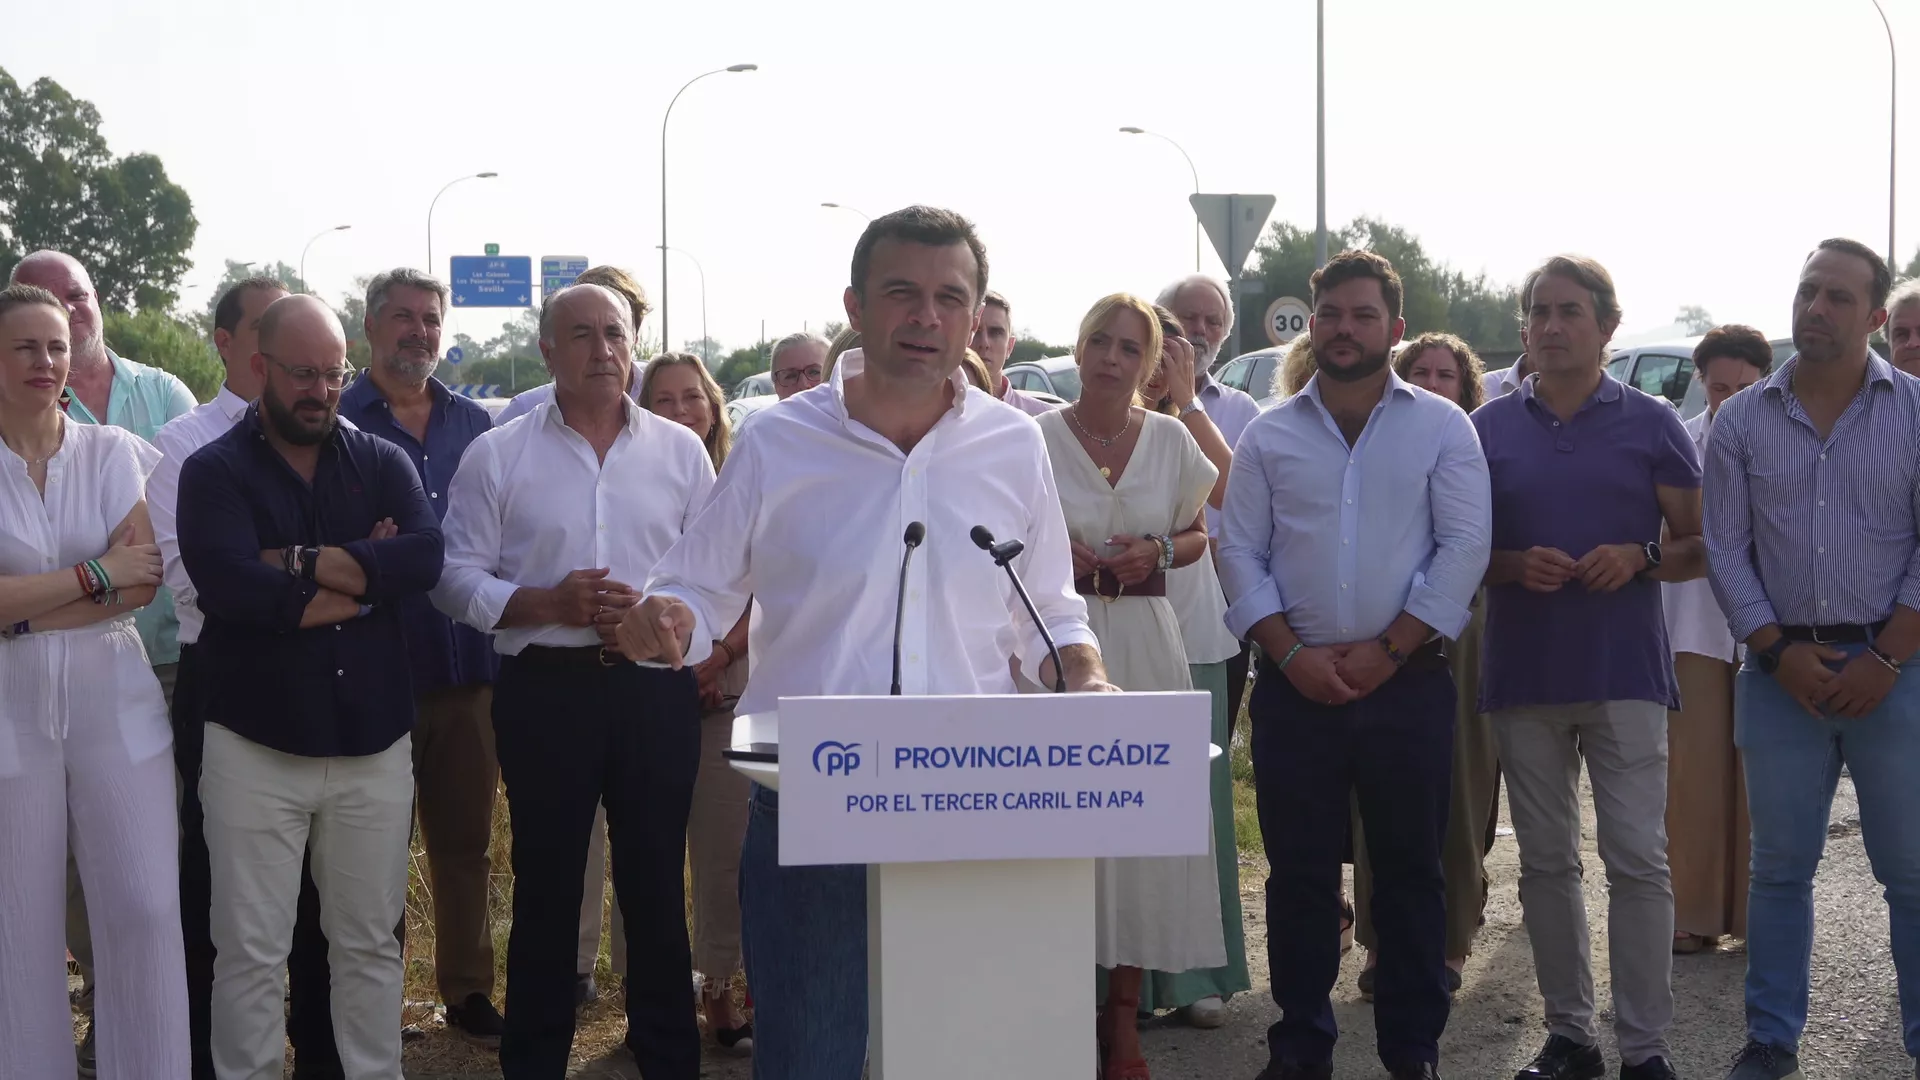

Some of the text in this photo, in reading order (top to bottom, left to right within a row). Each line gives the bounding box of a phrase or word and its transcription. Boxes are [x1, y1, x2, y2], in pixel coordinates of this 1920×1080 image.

[1275, 314, 1304, 332] 30
[895, 739, 1170, 769] PROVINCIA DE CÁDIZ
[847, 791, 1144, 813] POR EL TERCER CARRIL EN AP4
